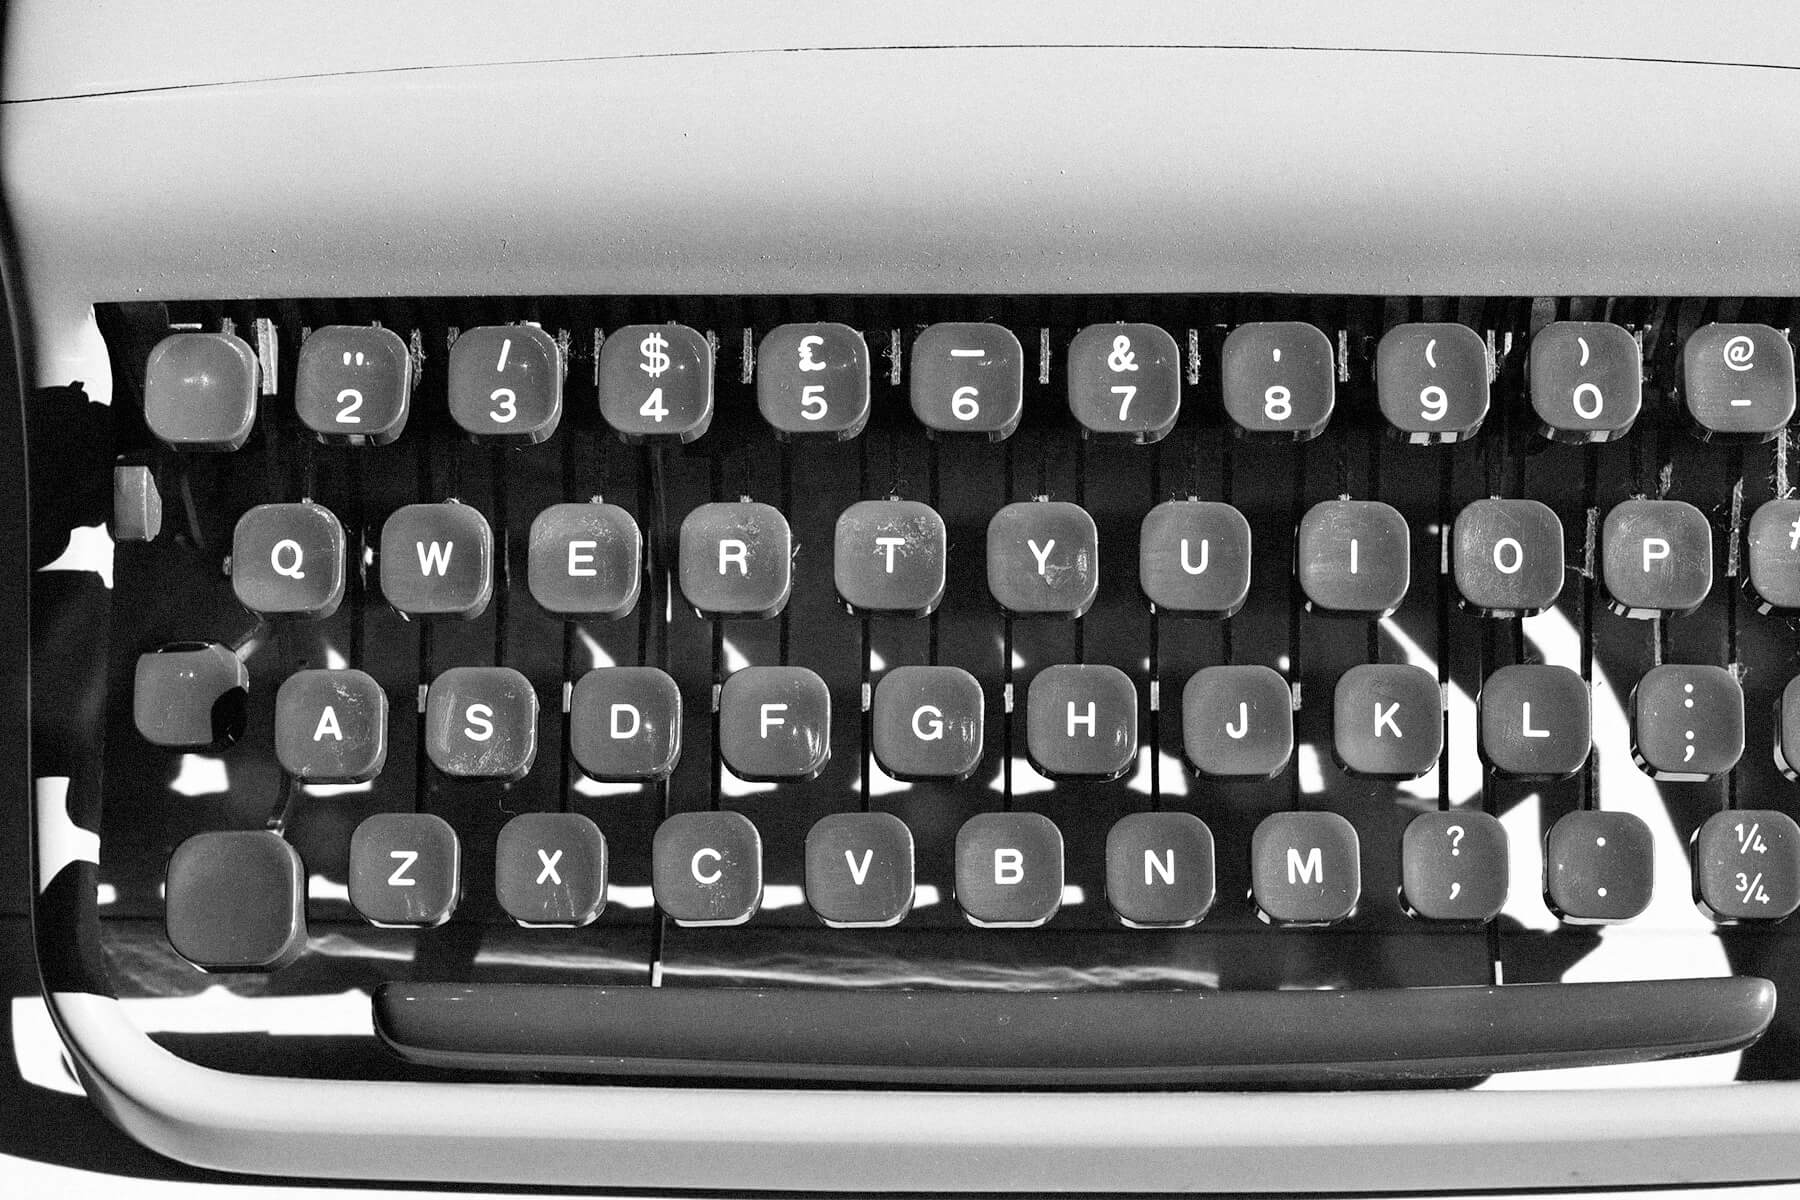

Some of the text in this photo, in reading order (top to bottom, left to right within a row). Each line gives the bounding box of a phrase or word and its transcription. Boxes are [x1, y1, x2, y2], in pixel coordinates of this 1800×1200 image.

[496, 338, 512, 372] /
[639, 332, 671, 378] $
[797, 335, 827, 372] £
[1107, 334, 1139, 373] &
[1425, 339, 1437, 369] (
[1577, 337, 1590, 367] )
[1723, 335, 1755, 372] @
[335, 388, 363, 424] 2
[489, 387, 517, 423] 3
[639, 387, 670, 423] 4
[800, 385, 828, 421] 5
[951, 385, 980, 421] 6
[1110, 385, 1137, 421] 7
[1264, 385, 1292, 421] 8
[1419, 385, 1448, 422] 9
[270, 539, 305, 580] Q
[416, 541, 454, 577] W
[568, 540, 598, 577] E
[718, 539, 748, 576] R
[875, 537, 906, 574] T
[1027, 539, 1056, 576] Y
[1180, 538, 1209, 575] U
[1350, 538, 1358, 574] I
[1493, 537, 1523, 574] O
[1642, 537, 1671, 573] P
[313, 705, 343, 742] A
[464, 703, 494, 742] S
[610, 703, 641, 739] D
[760, 703, 788, 739] F
[911, 704, 944, 741] G
[1067, 701, 1096, 738] H
[1225, 702, 1248, 739] J
[1374, 702, 1403, 738] K
[1522, 701, 1550, 738] L
[1683, 730, 1695, 762] ;
[1446, 825, 1465, 857] ?
[387, 850, 419, 886] Z
[536, 849, 563, 885] X
[691, 847, 722, 885] C
[844, 849, 874, 885] V
[994, 848, 1025, 885] B
[1144, 849, 1175, 886] N
[1286, 846, 1323, 885] M
